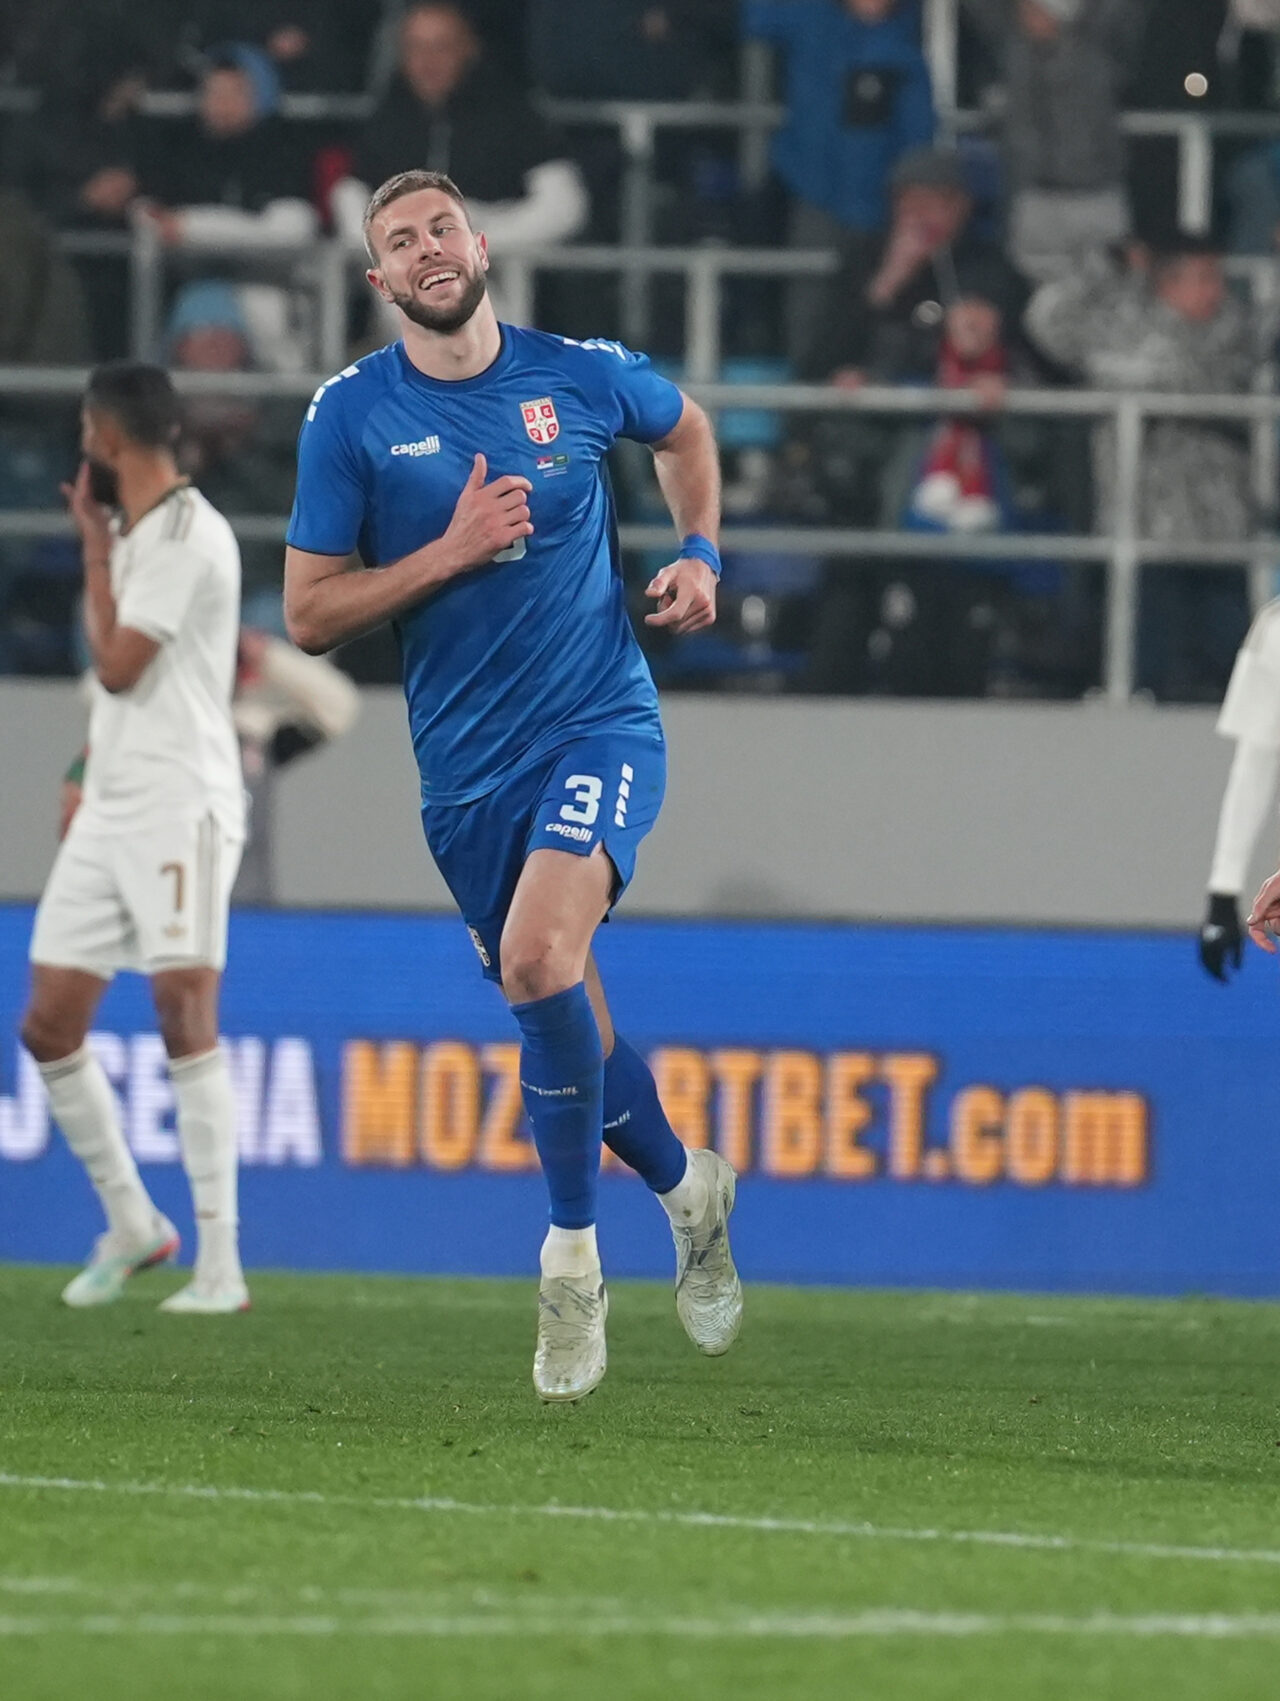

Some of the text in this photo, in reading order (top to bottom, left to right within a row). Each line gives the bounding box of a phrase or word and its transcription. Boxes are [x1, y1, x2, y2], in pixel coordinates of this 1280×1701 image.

[391, 435, 441, 457] capelli
[559, 774, 603, 825] 3
[545, 823, 593, 843] capelli
[340, 1038, 1148, 1185] MOZRTBET.com
